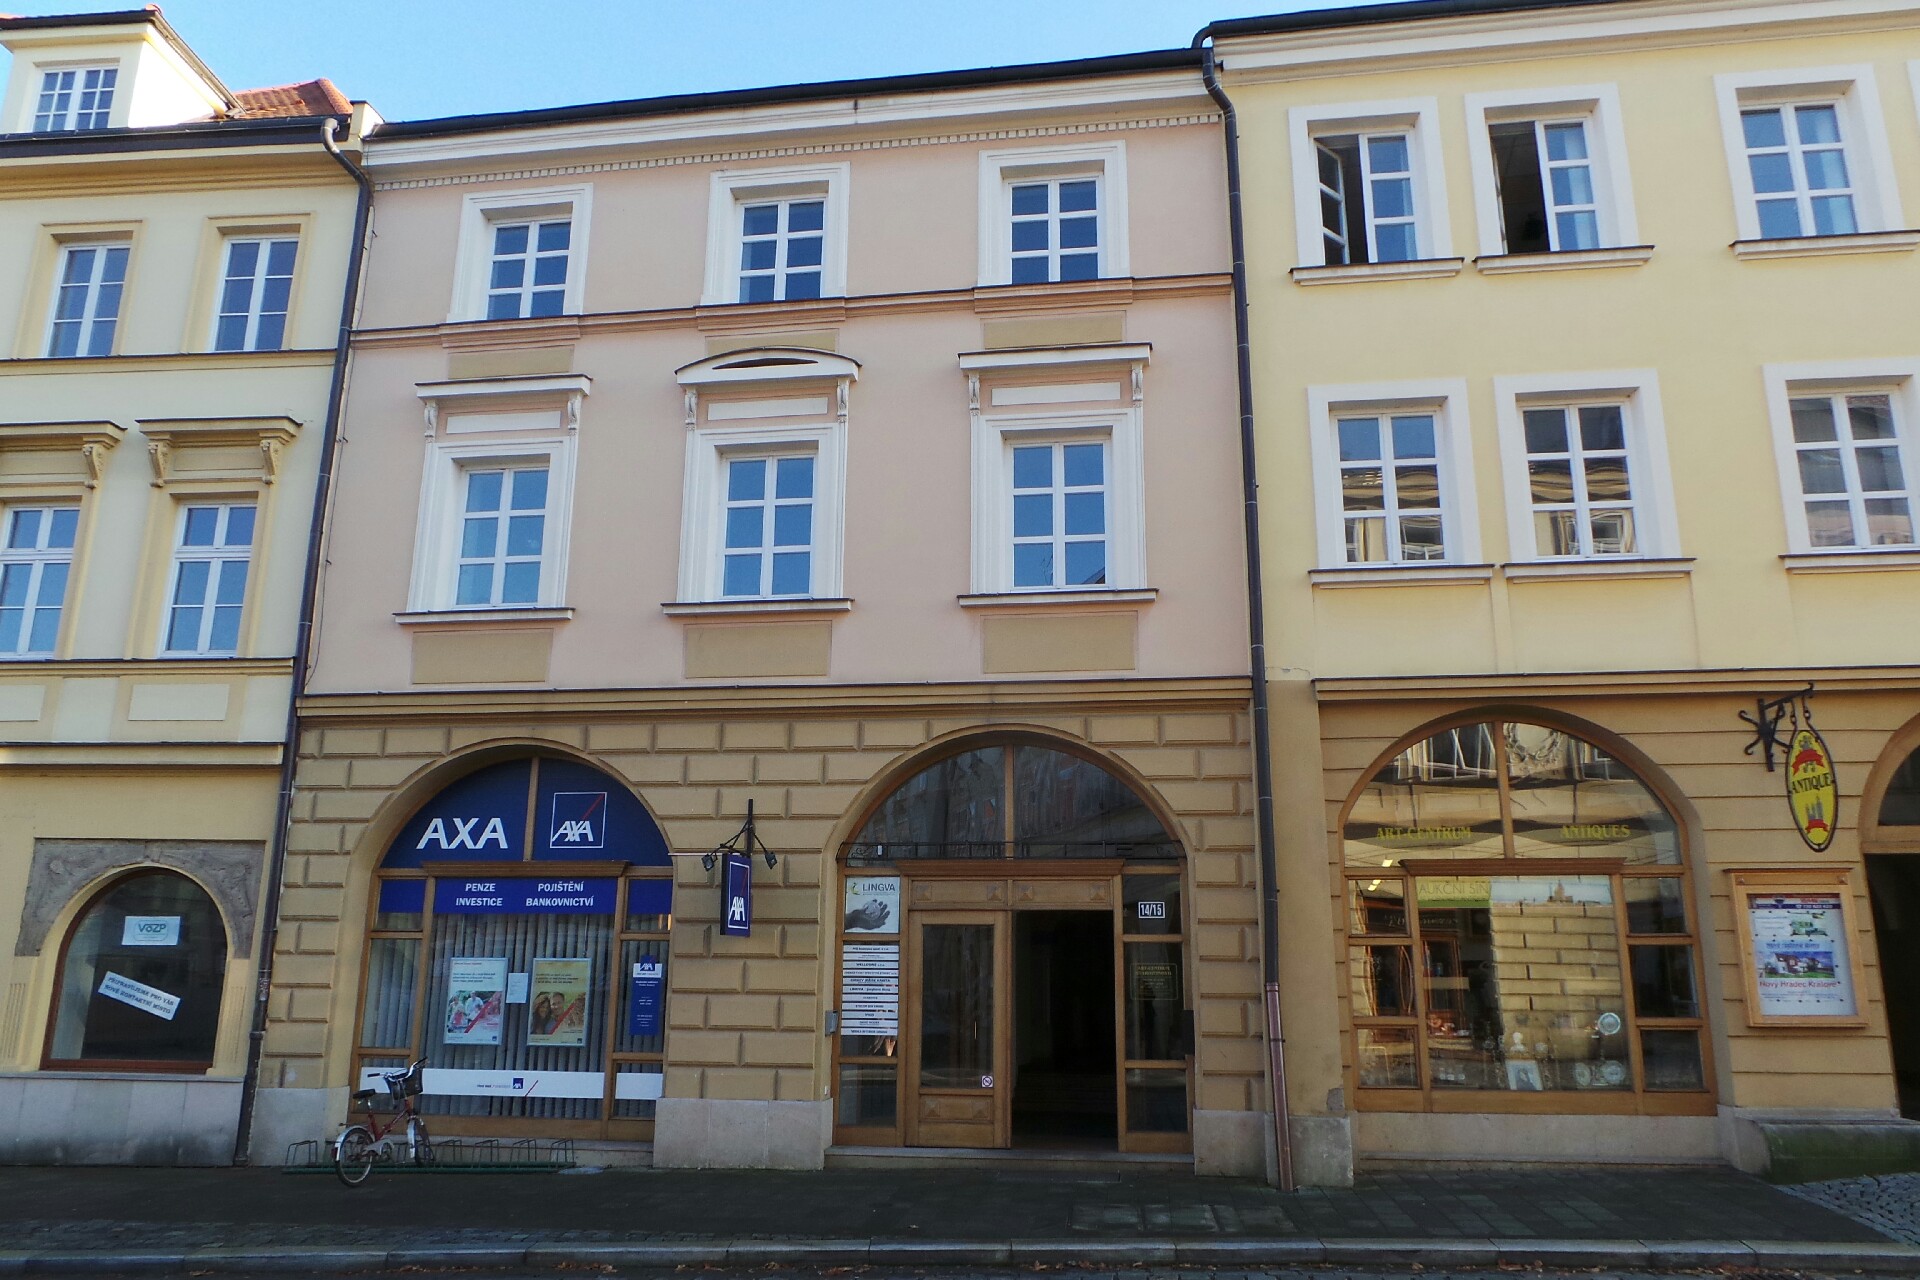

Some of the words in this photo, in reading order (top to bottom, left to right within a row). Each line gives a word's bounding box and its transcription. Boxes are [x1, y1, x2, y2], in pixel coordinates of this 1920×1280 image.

[1791, 772, 1832, 794] ANTIQUE
[416, 817, 508, 849] AXA
[550, 820, 594, 842] AXA
[1560, 824, 1631, 839] ANTIQUES
[465, 883, 496, 892] PENZE
[537, 881, 584, 892] POJIŠTĚNÍ
[862, 883, 896, 891] LINGVA
[455, 897, 503, 907] INVESTICE
[526, 895, 594, 907] BANKOVNICTVÍ
[729, 896, 745, 921] AXA
[1141, 904, 1162, 916] 14/15
[640, 963, 653, 971] AXA
[150, 993, 162, 1001] PRO
